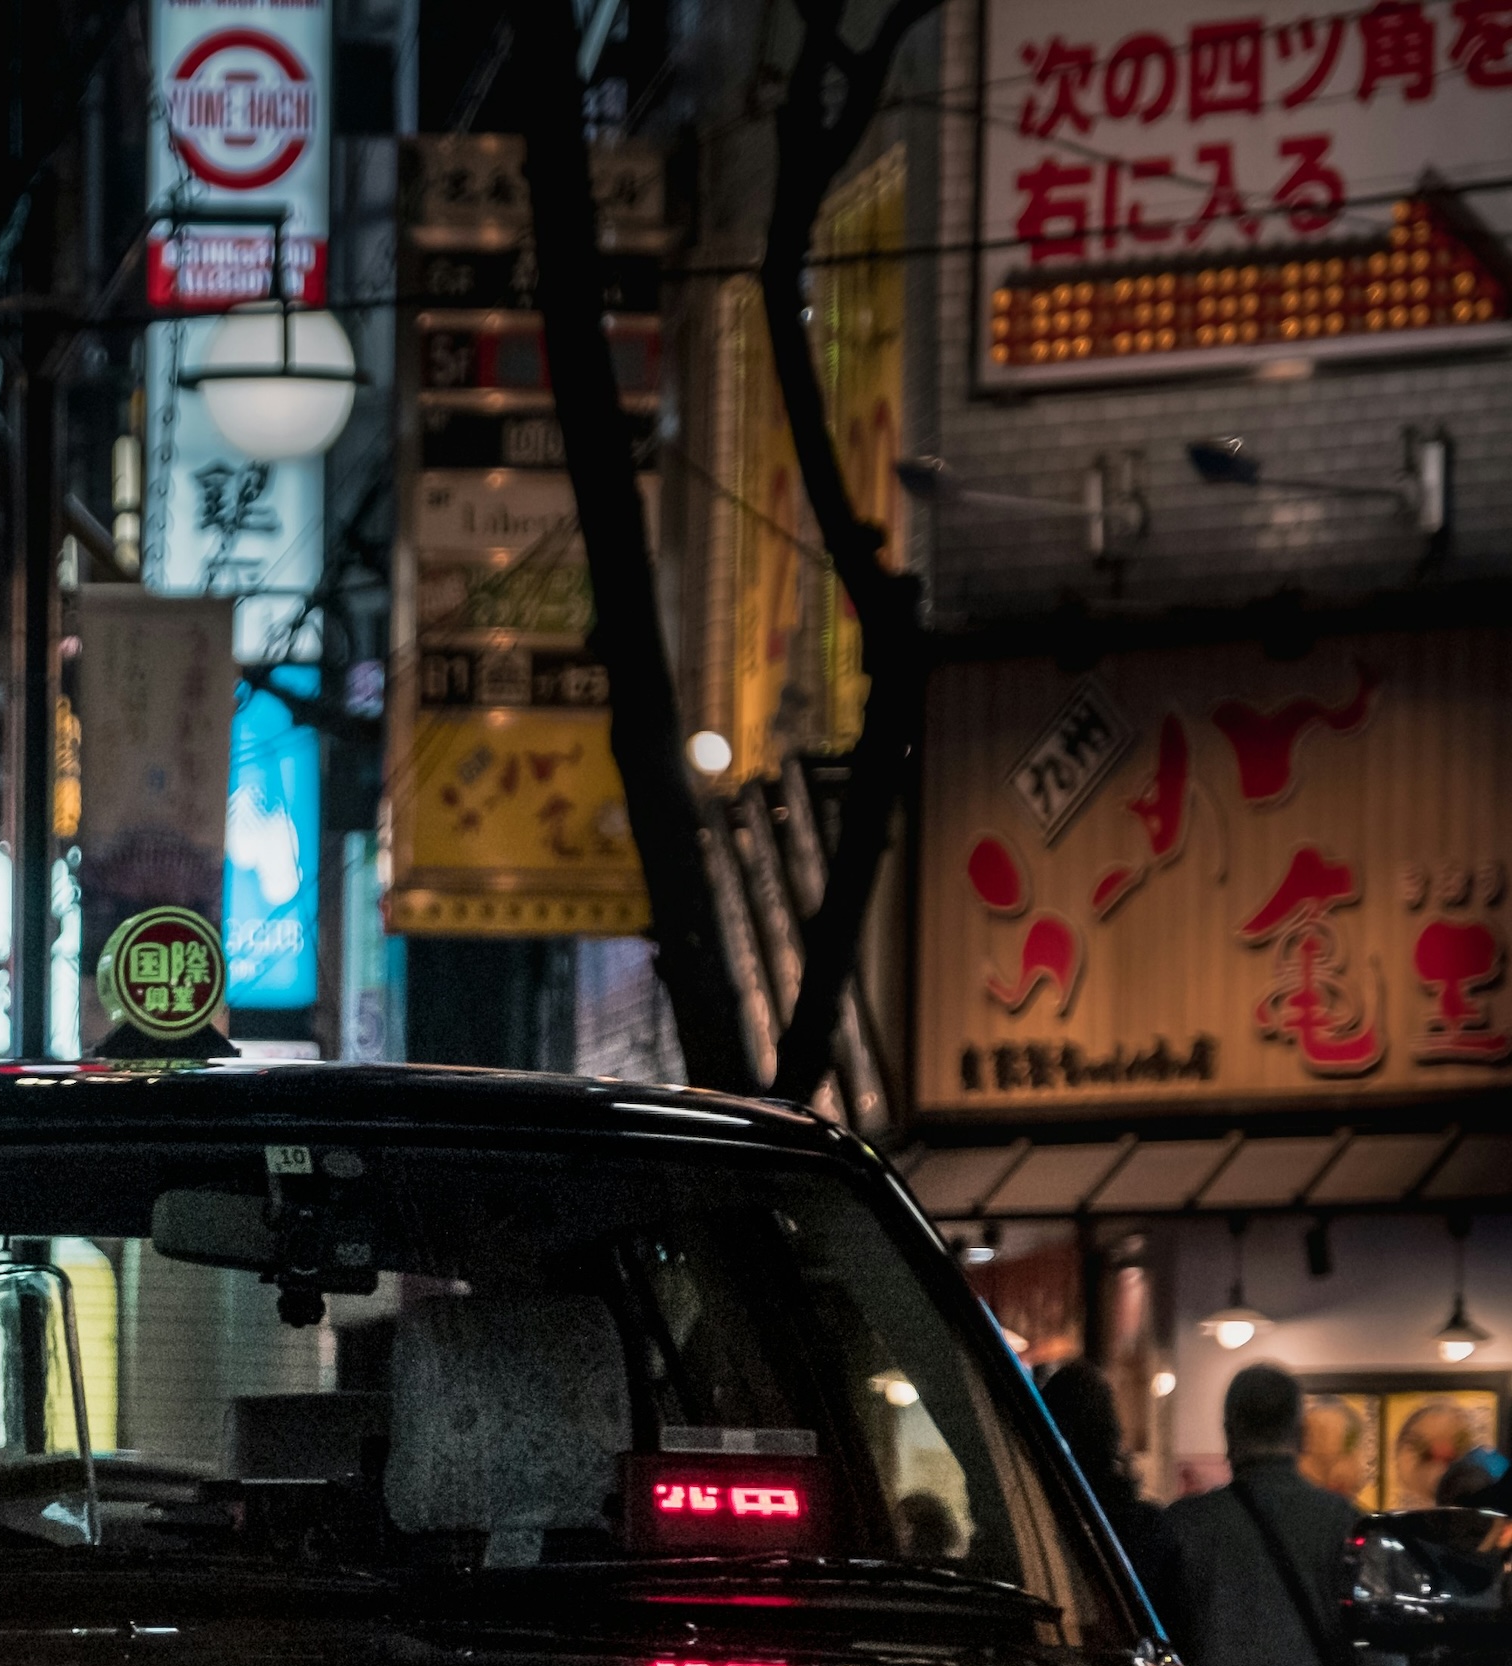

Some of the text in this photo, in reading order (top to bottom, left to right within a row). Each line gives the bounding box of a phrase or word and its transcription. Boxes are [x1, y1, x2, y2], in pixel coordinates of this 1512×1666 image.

[1016, 135, 1346, 264] 右に入る
[129, 940, 212, 984] 国際
